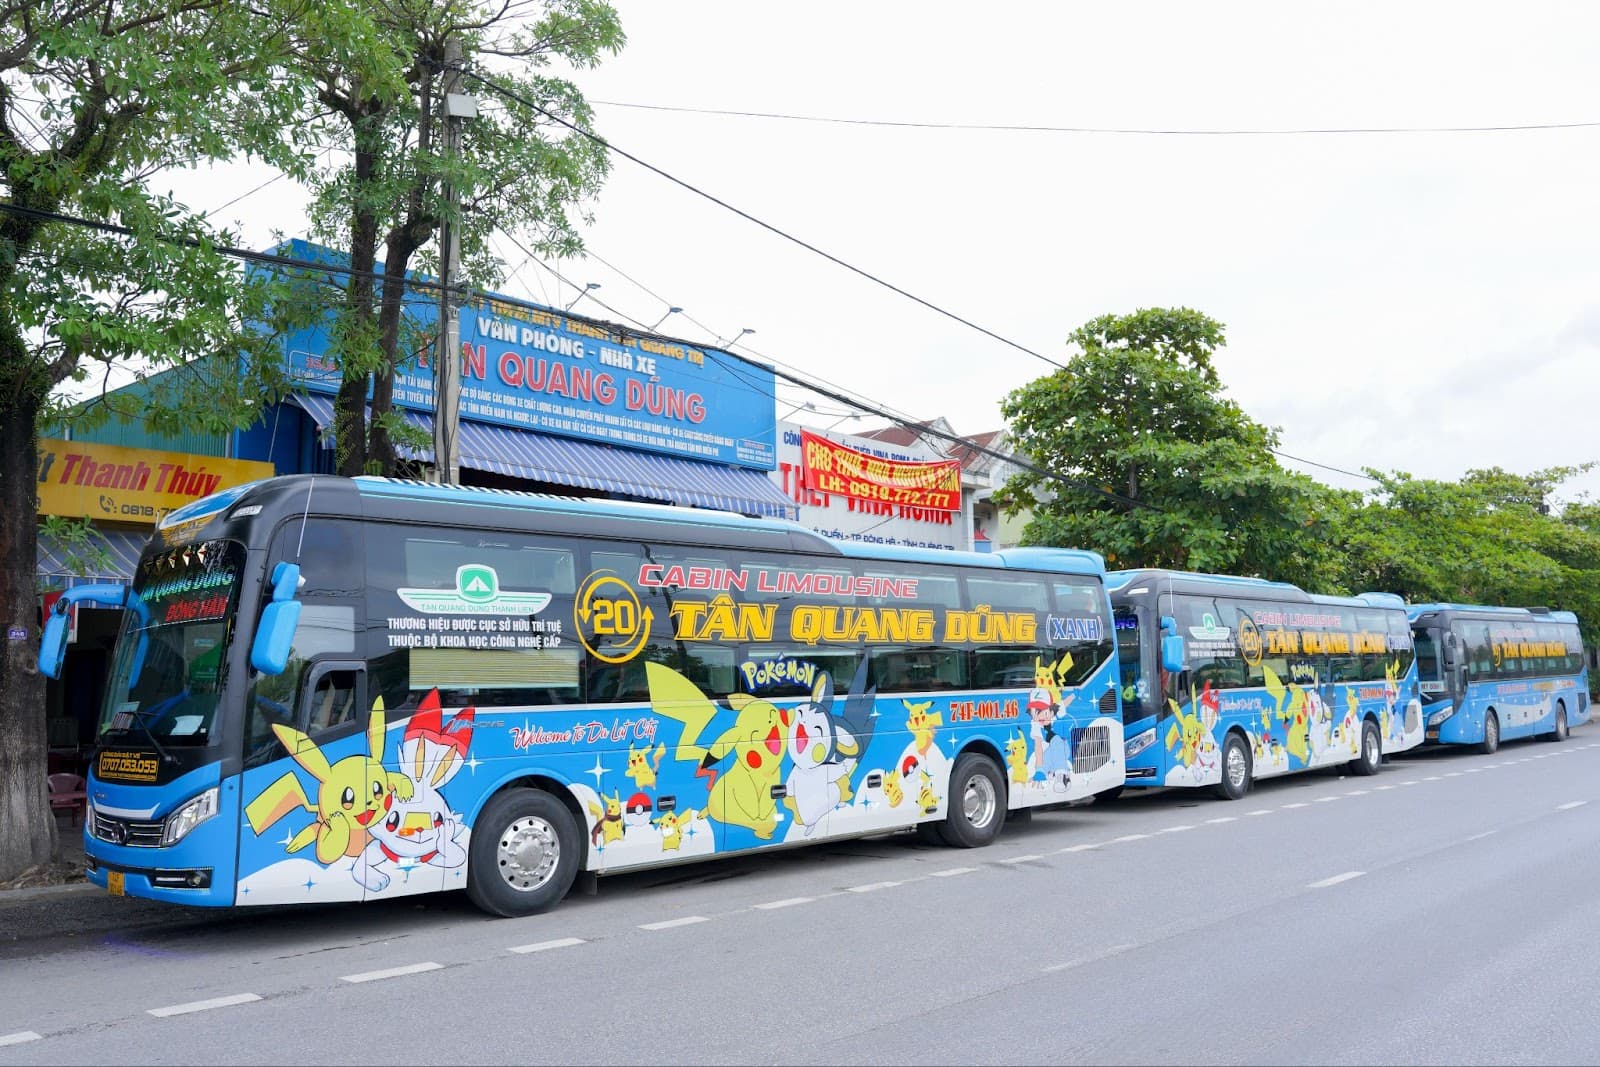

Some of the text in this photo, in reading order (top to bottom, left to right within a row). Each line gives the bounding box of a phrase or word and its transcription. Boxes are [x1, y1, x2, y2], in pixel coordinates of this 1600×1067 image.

[478, 315, 517, 344] VĂN
[521, 327, 584, 359] PHÒNG
[600, 347, 633, 371] NHÀ
[636, 355, 656, 376] XE
[498, 351, 617, 406] QUANG
[625, 375, 706, 424] DŨNG
[783, 430, 802, 447] CÔN
[806, 440, 832, 471] CHO
[59, 454, 151, 492] Thanh
[154, 463, 222, 499] Thúy
[819, 474, 846, 493] LH:
[638, 564, 919, 599] CABIN LIMOUSINE
[387, 616, 562, 634] THƯƠNG HIỆU ĐƯỢC CỤC SỞ HỮU TRÍ TUỆ
[593, 600, 636, 635] 20
[669, 593, 1104, 646] TÂN QUANG DŨNG (XANH)
[387, 633, 561, 650] THUỘC BỘ KHOA HỌC CÔNG NGHỆ CẤP
[1245, 631, 1259, 651] 20
[1265, 625, 1299, 654] TÂN
[1302, 631, 1350, 655] QUANG
[1352, 629, 1386, 654] DŨNG
[951, 699, 1019, 722] 74F-001.46
[509, 724, 573, 751] Welcome
[572, 721, 586, 745] to
[585, 719, 608, 744] Da
[633, 717, 658, 744] City
[102, 758, 157, 774] 0707.053.053
